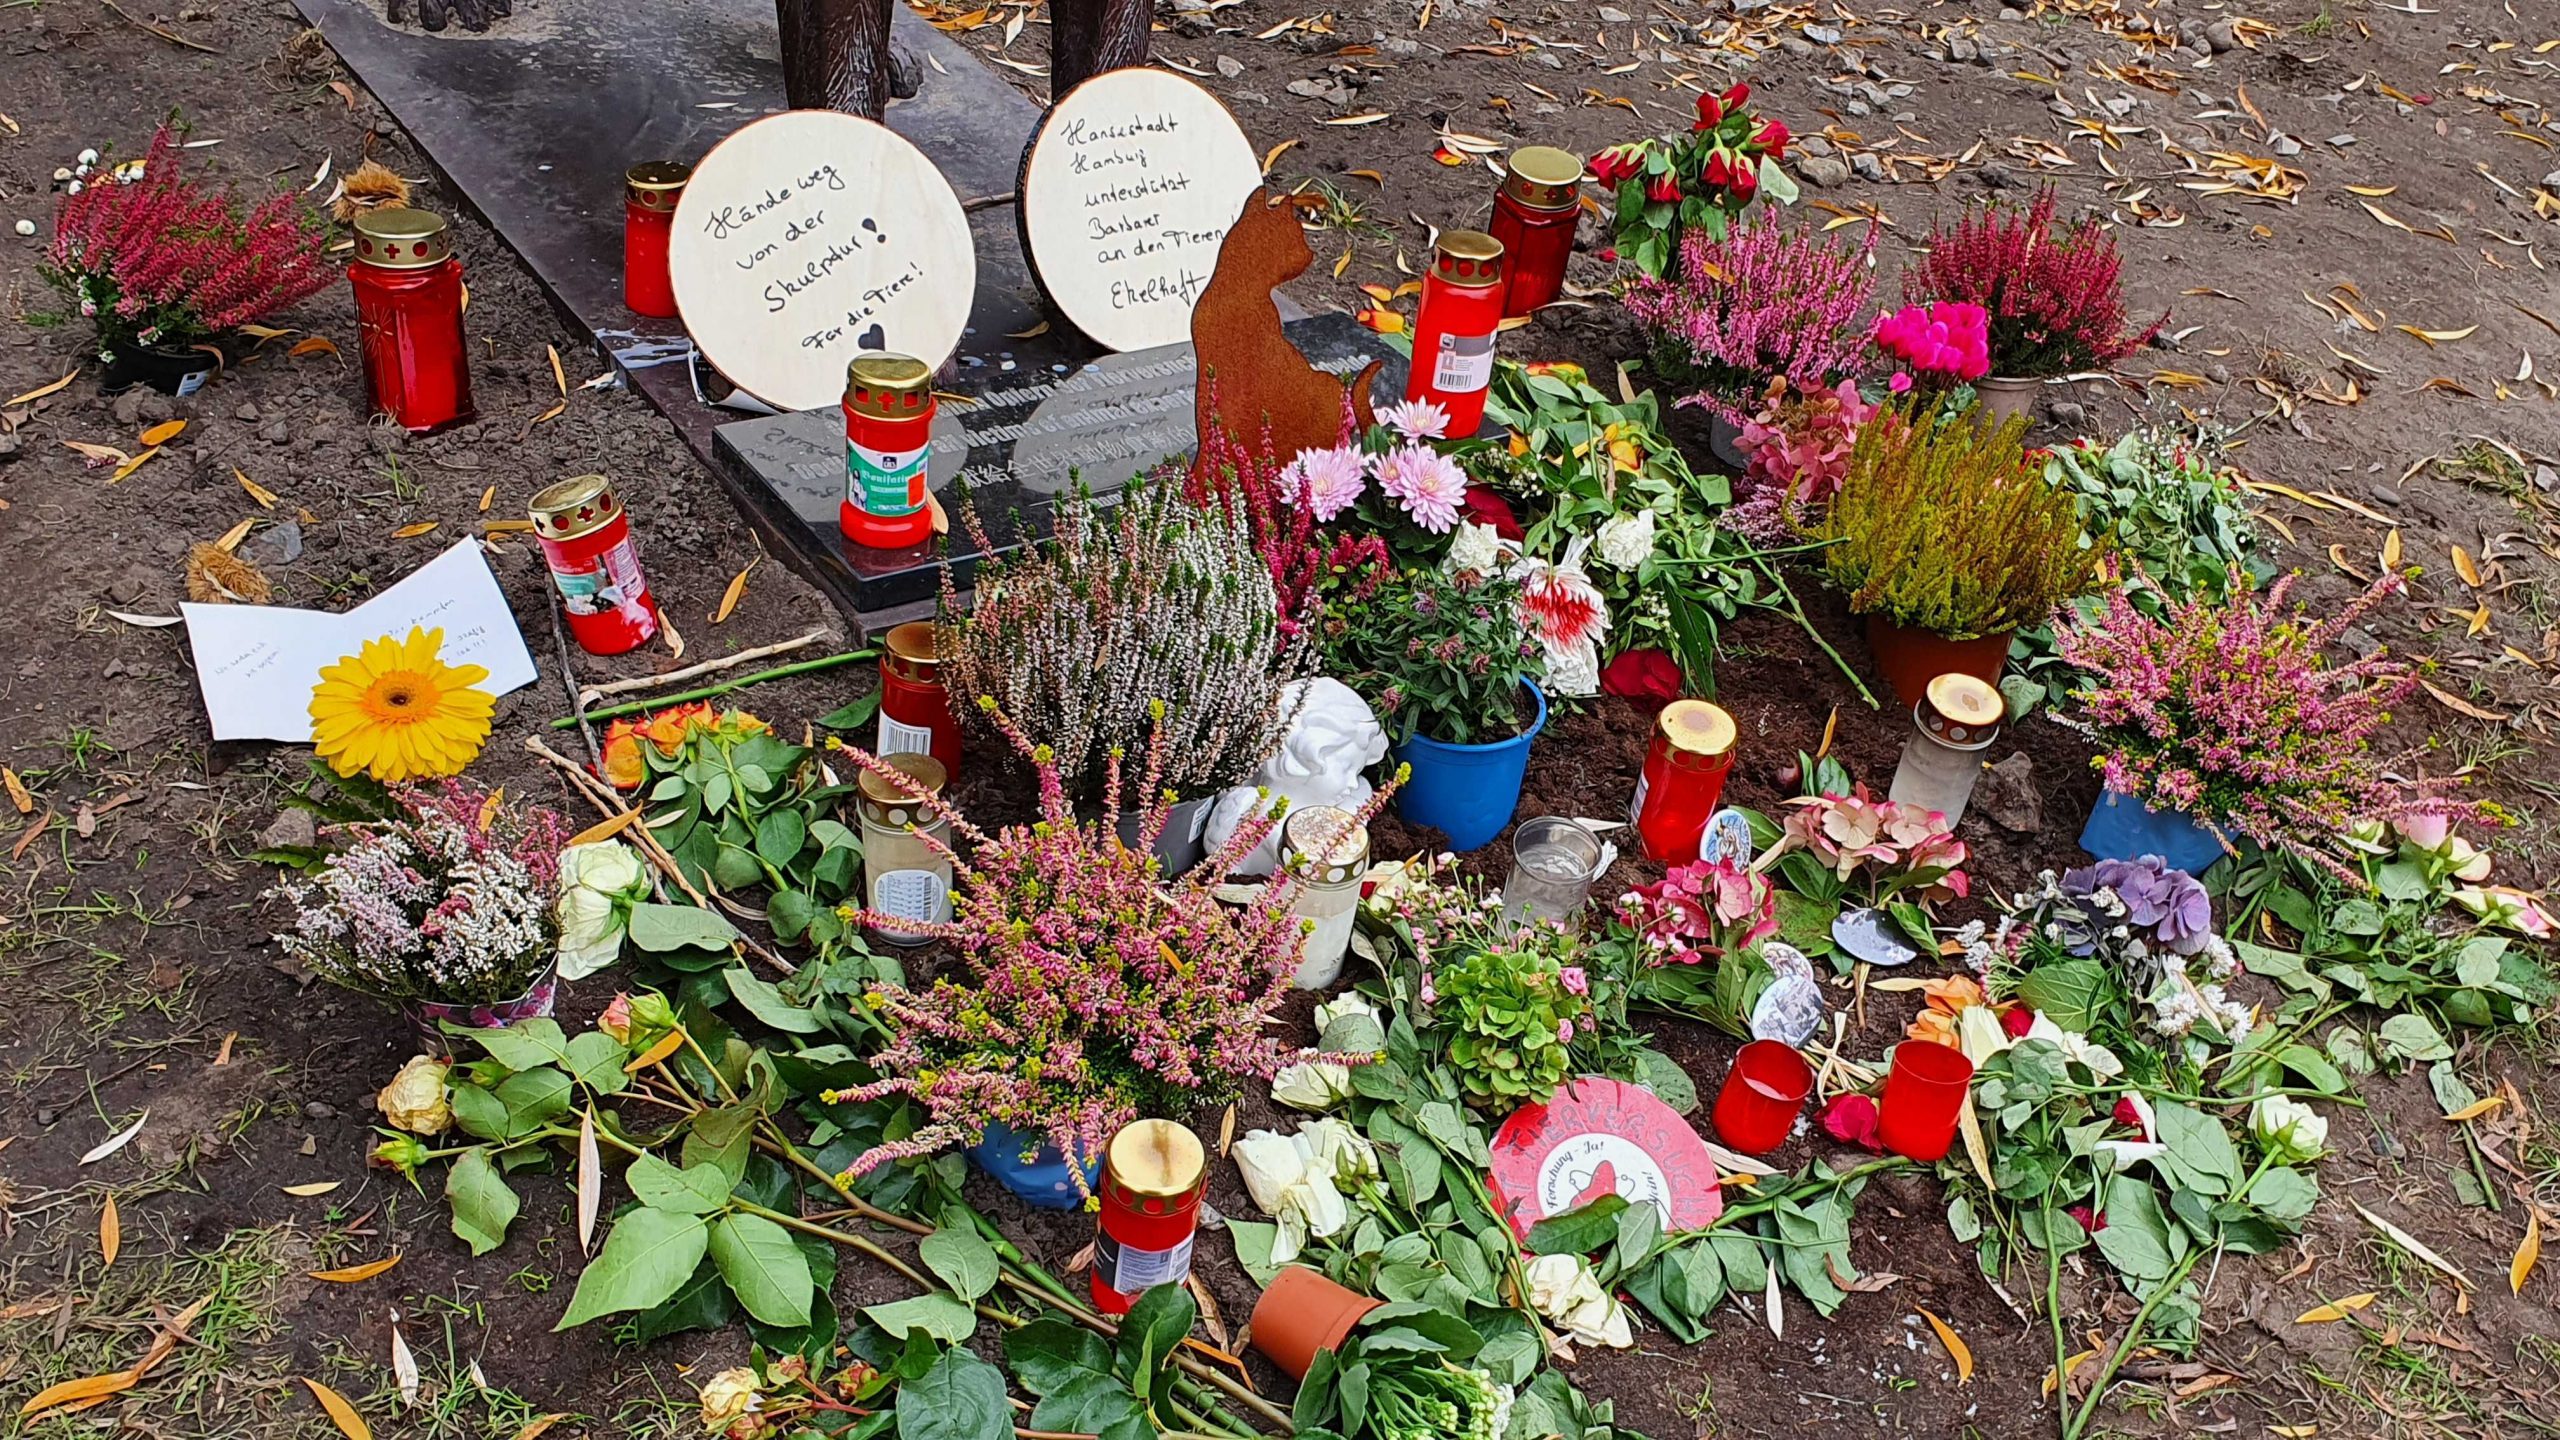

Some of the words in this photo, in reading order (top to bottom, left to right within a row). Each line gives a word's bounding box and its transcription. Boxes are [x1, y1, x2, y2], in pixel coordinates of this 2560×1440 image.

[1060, 112, 1179, 146] Hansestadt
[1070, 149, 1147, 174] Hamburg
[704, 189, 792, 239] Hände
[797, 165, 846, 190] weg
[736, 243, 779, 269] von
[785, 210, 826, 242] der
[1098, 249, 1127, 263] an
[1134, 238, 1166, 256] den
[1111, 268, 1207, 309] Ekelhaft
[847, 307, 874, 326] die
[960, 422, 1041, 447] victims
[1545, 1150, 1575, 1209] Forschung
[1583, 1140, 1605, 1155] Ja!
